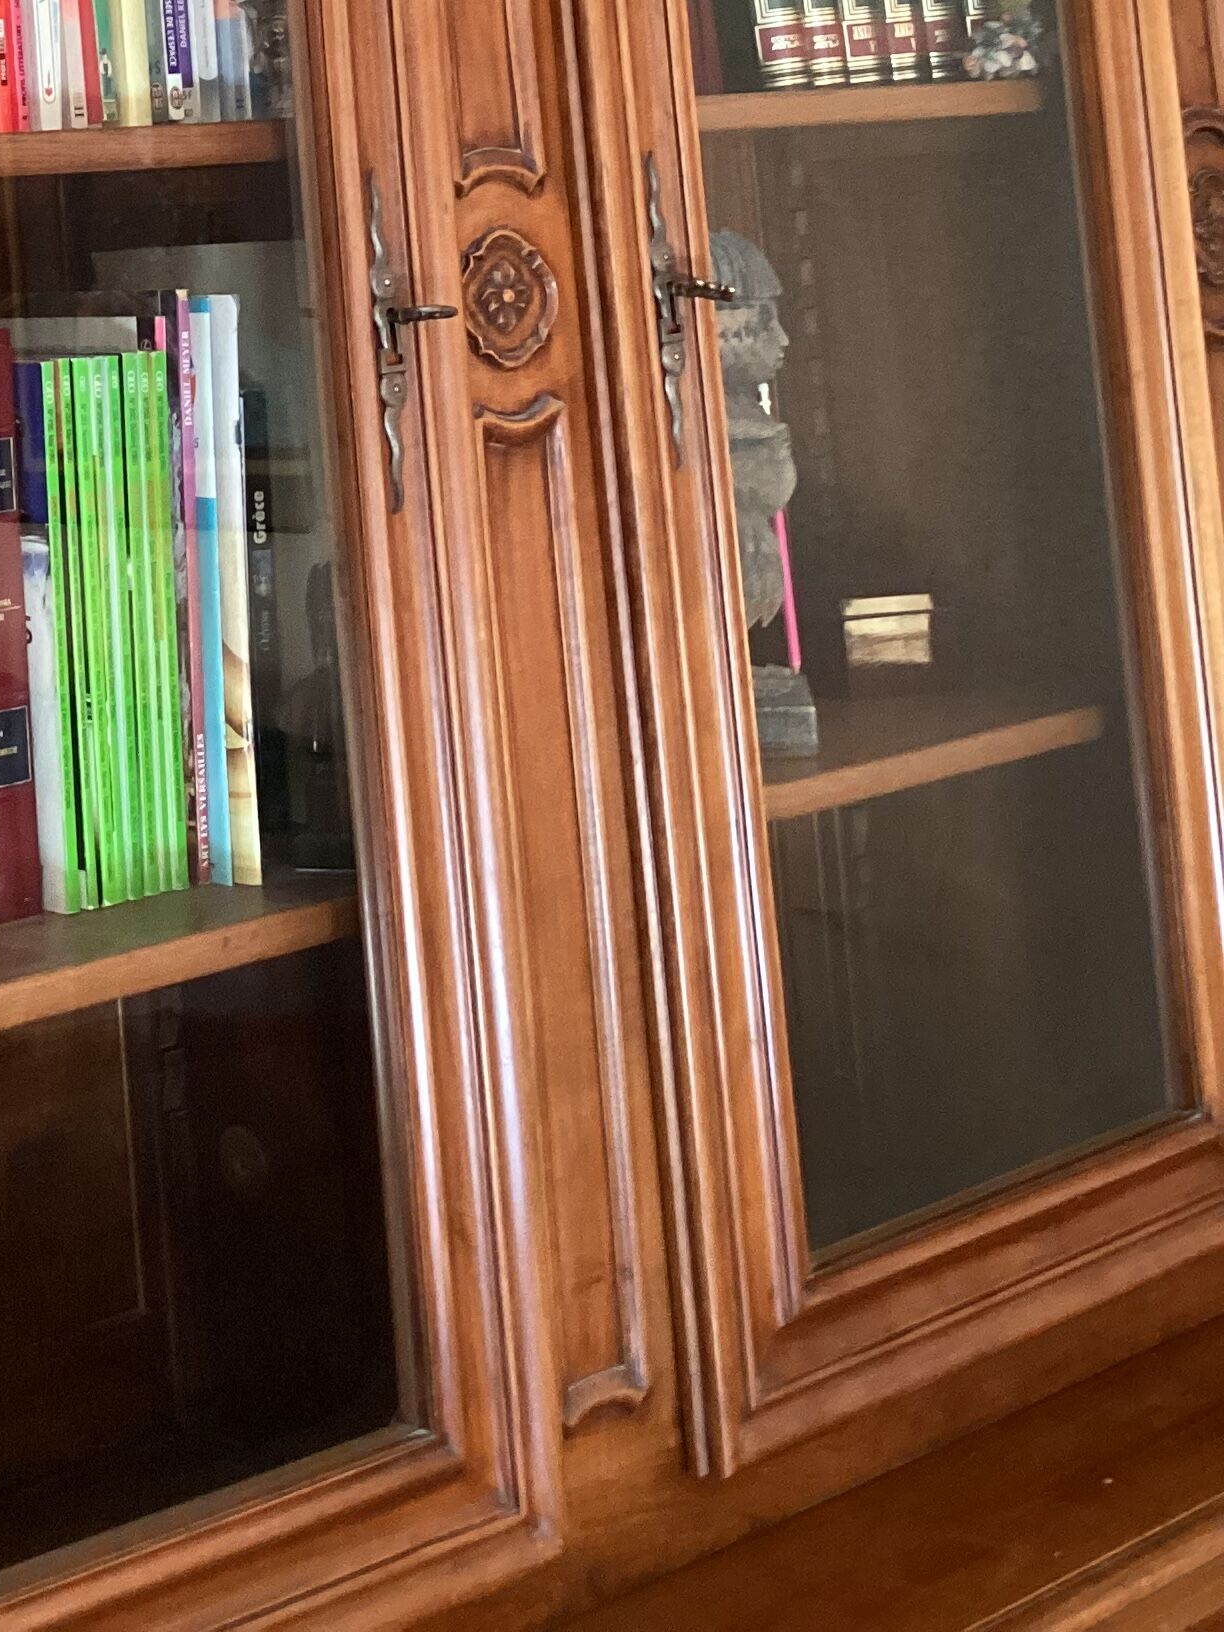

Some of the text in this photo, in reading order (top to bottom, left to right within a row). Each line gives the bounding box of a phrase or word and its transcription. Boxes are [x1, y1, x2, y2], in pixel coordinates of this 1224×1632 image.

[165, 16, 174, 28] DE
[177, 14, 187, 48] DANIEL
[167, 29, 178, 67] L'ESPACE
[181, 331, 193, 426] DANIEL MEYER
[251, 490, 267, 545] Grèce
[196, 733, 209, 869] ART LYS VERSAILLES
